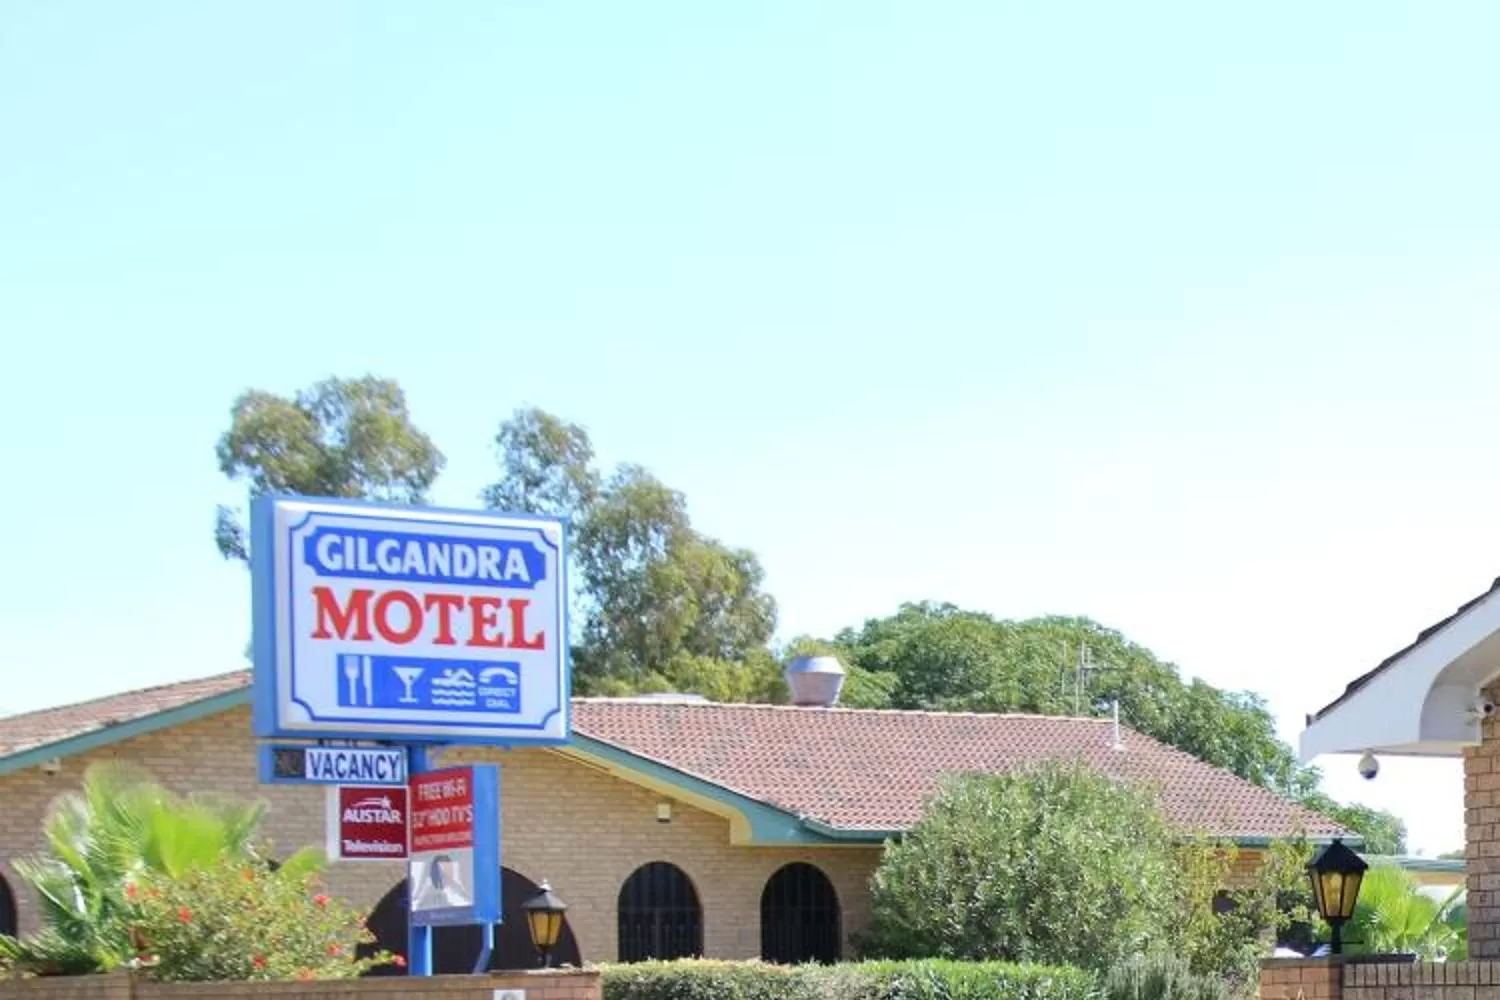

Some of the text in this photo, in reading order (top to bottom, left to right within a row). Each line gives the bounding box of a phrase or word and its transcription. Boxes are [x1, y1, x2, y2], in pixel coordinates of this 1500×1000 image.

[317, 533, 530, 582] GILGANDRA
[311, 586, 545, 650] MOTEL
[309, 752, 399, 779] VACANCY
[342, 808, 402, 823] AUSTAR
[342, 840, 404, 853] Television
